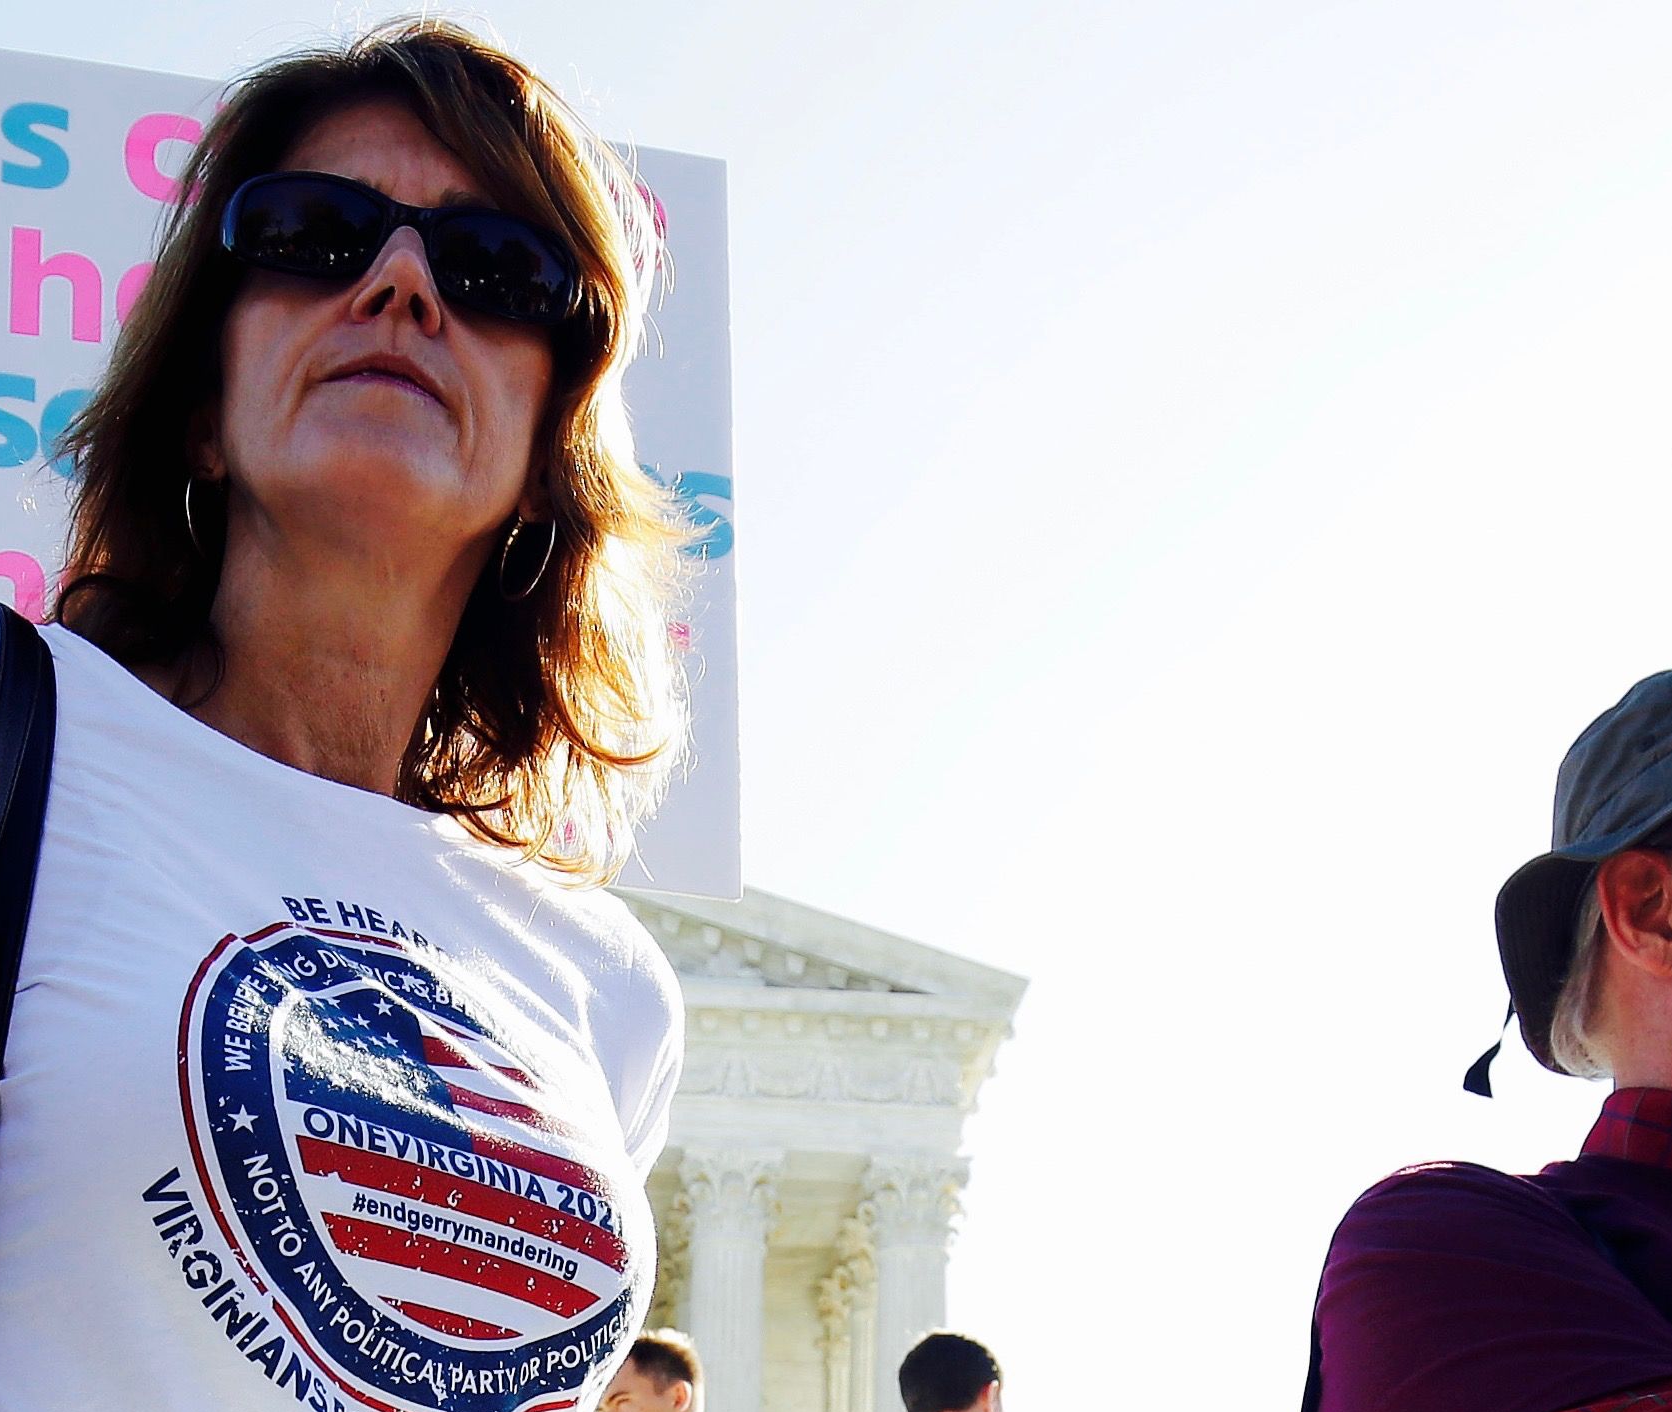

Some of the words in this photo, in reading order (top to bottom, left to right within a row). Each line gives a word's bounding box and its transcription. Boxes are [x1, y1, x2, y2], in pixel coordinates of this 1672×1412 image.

[281, 896, 332, 925] BE
[303, 1107, 548, 1205] ONEVIRGINIA
[556, 1183, 618, 1236] 202
[243, 1153, 287, 1215] NOT
[271, 1215, 304, 1258] TO
[292, 1261, 339, 1313] ANY
[329, 1305, 446, 1389] POLITICAL
[519, 1356, 541, 1387] OR
[352, 1191, 579, 1281] #endgerrymandering
